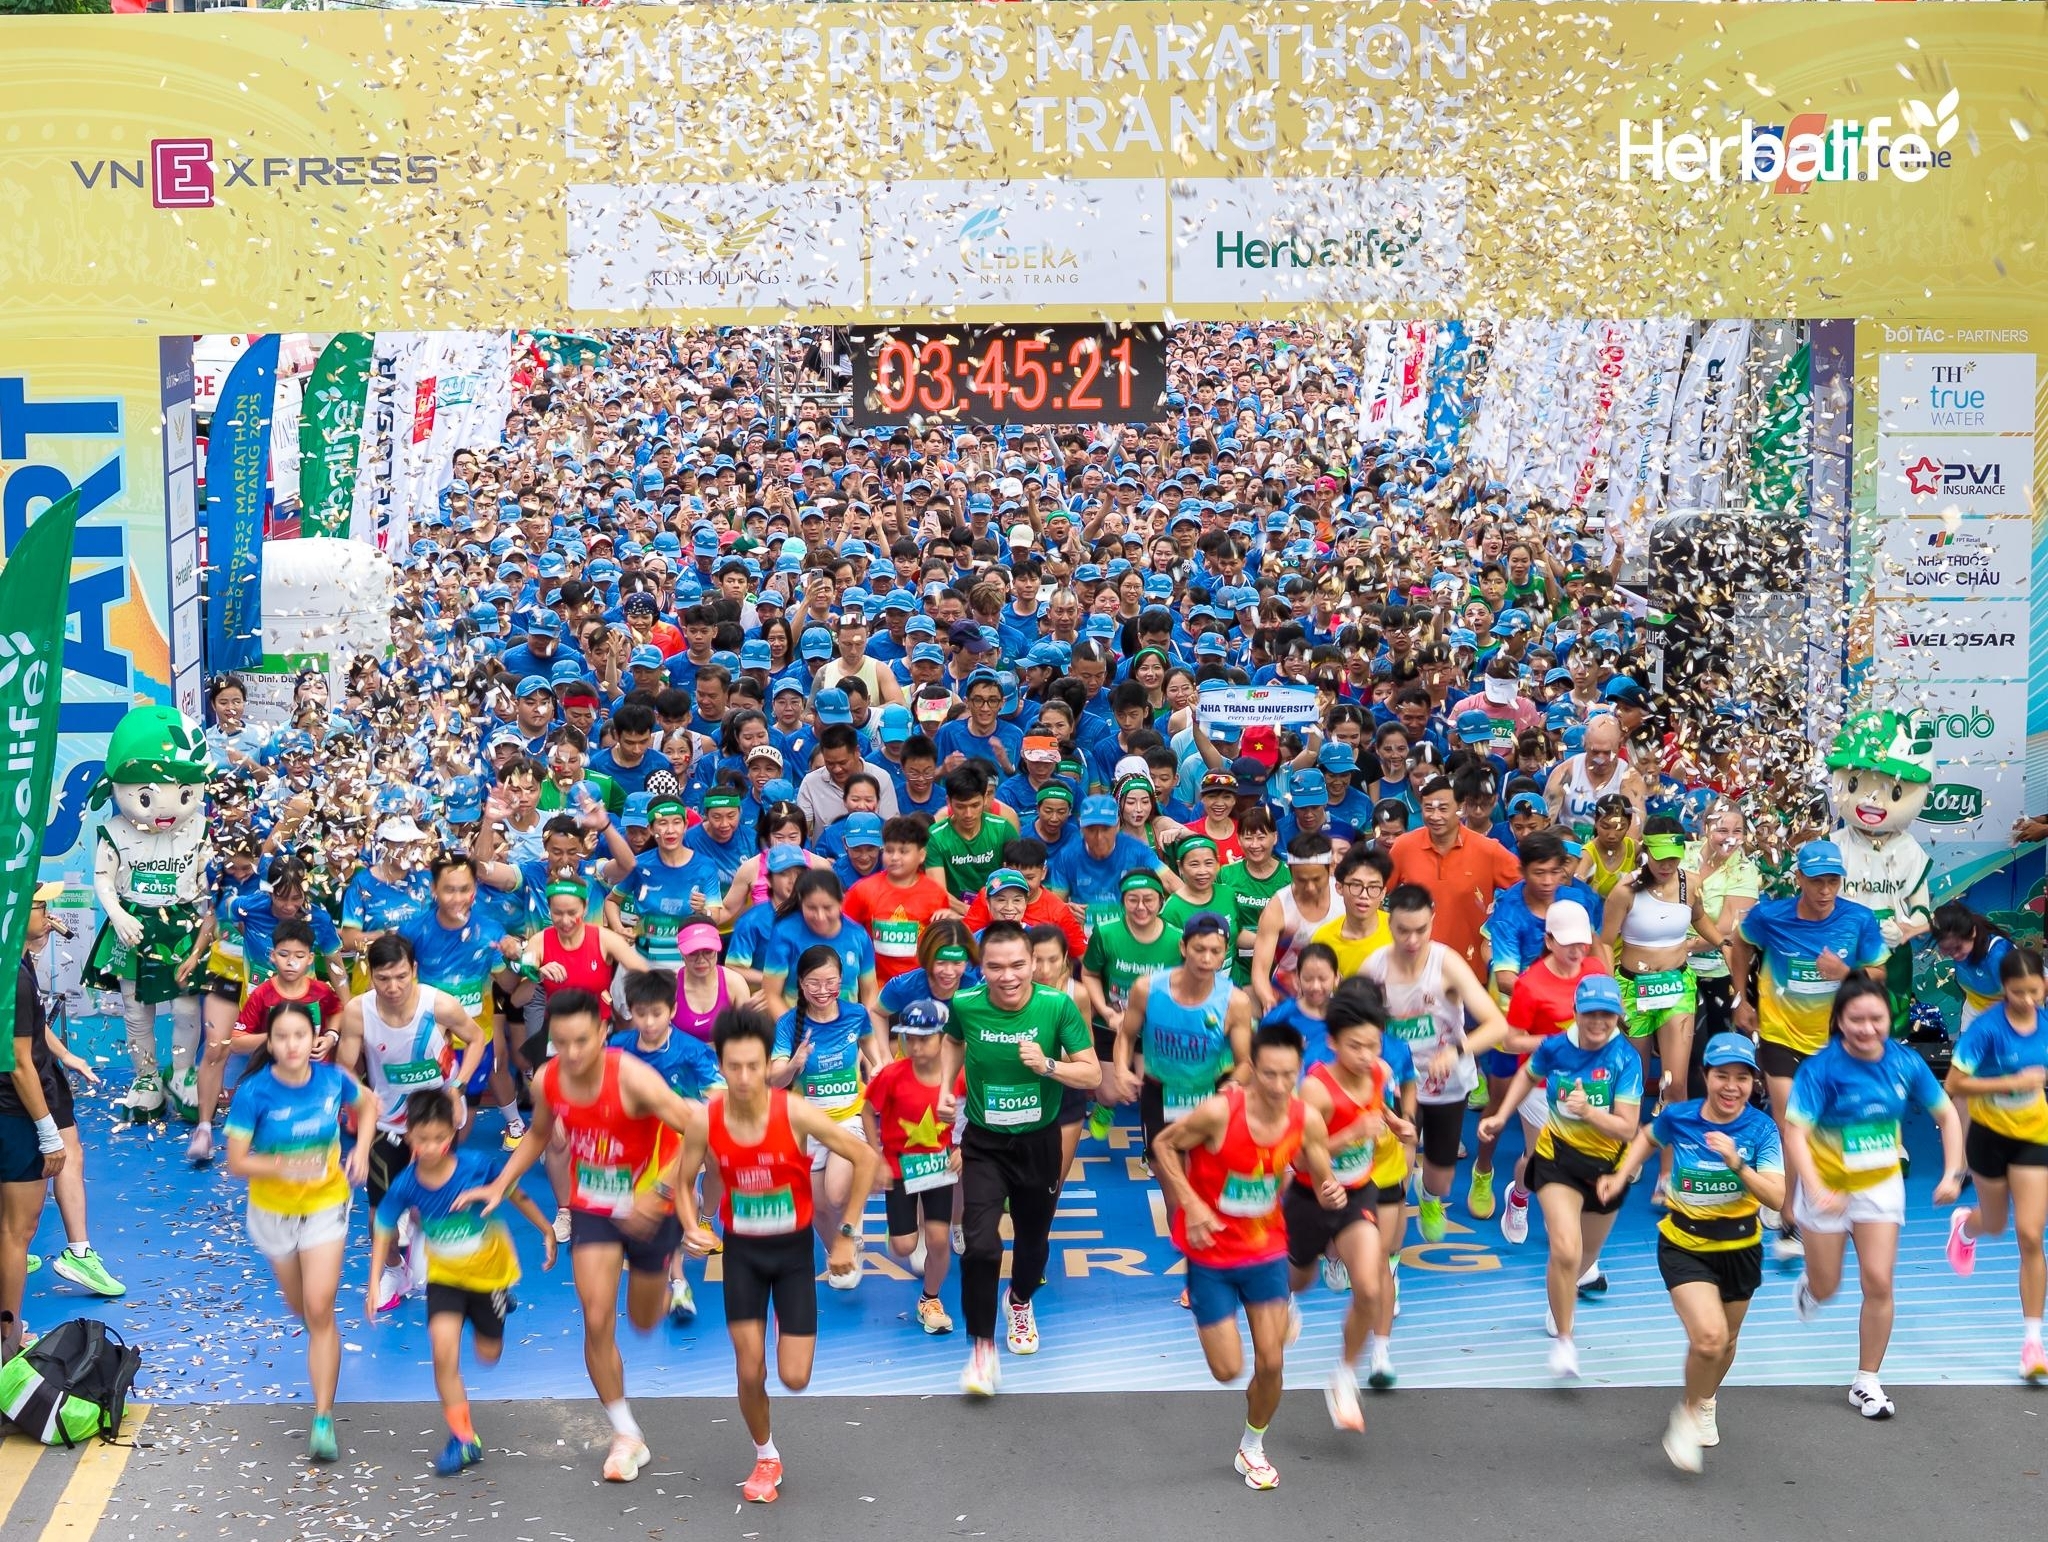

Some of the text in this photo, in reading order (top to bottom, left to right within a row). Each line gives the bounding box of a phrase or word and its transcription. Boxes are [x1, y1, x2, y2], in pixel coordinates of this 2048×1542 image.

[1035, 24, 1467, 82] MARATHON
[1017, 95, 1276, 153] TRANG
[1216, 229, 1407, 269] Herbalife
[980, 246, 1078, 270] LIBERA
[1024, 273, 1079, 284] TRANG
[1917, 326, 1945, 342] TÁC
[1957, 329, 2029, 342] PARTNERS
[878, 336, 1132, 412] 03:45:21
[1931, 366, 1963, 383] TH
[1930, 385, 1985, 409] true
[1931, 412, 1985, 428] WATER
[234, 394, 250, 515] MARATHON
[247, 446, 261, 516] TRANG
[1943, 463, 2000, 485] PVI
[1943, 485, 2006, 495] INSURANCE
[1955, 568, 2000, 586] CHÂU
[1909, 632, 2016, 647] VELOSAR
[1200, 704, 1315, 713] NHA TRANG UNIVERSITY
[1648, 981, 1684, 996] 50845
[980, 1029, 1034, 1044] Herbalife
[400, 1068, 437, 1083] 52619
[817, 1081, 857, 1095] 50007
[999, 1095, 1038, 1109] 50149
[1695, 1181, 1738, 1192] 51480
